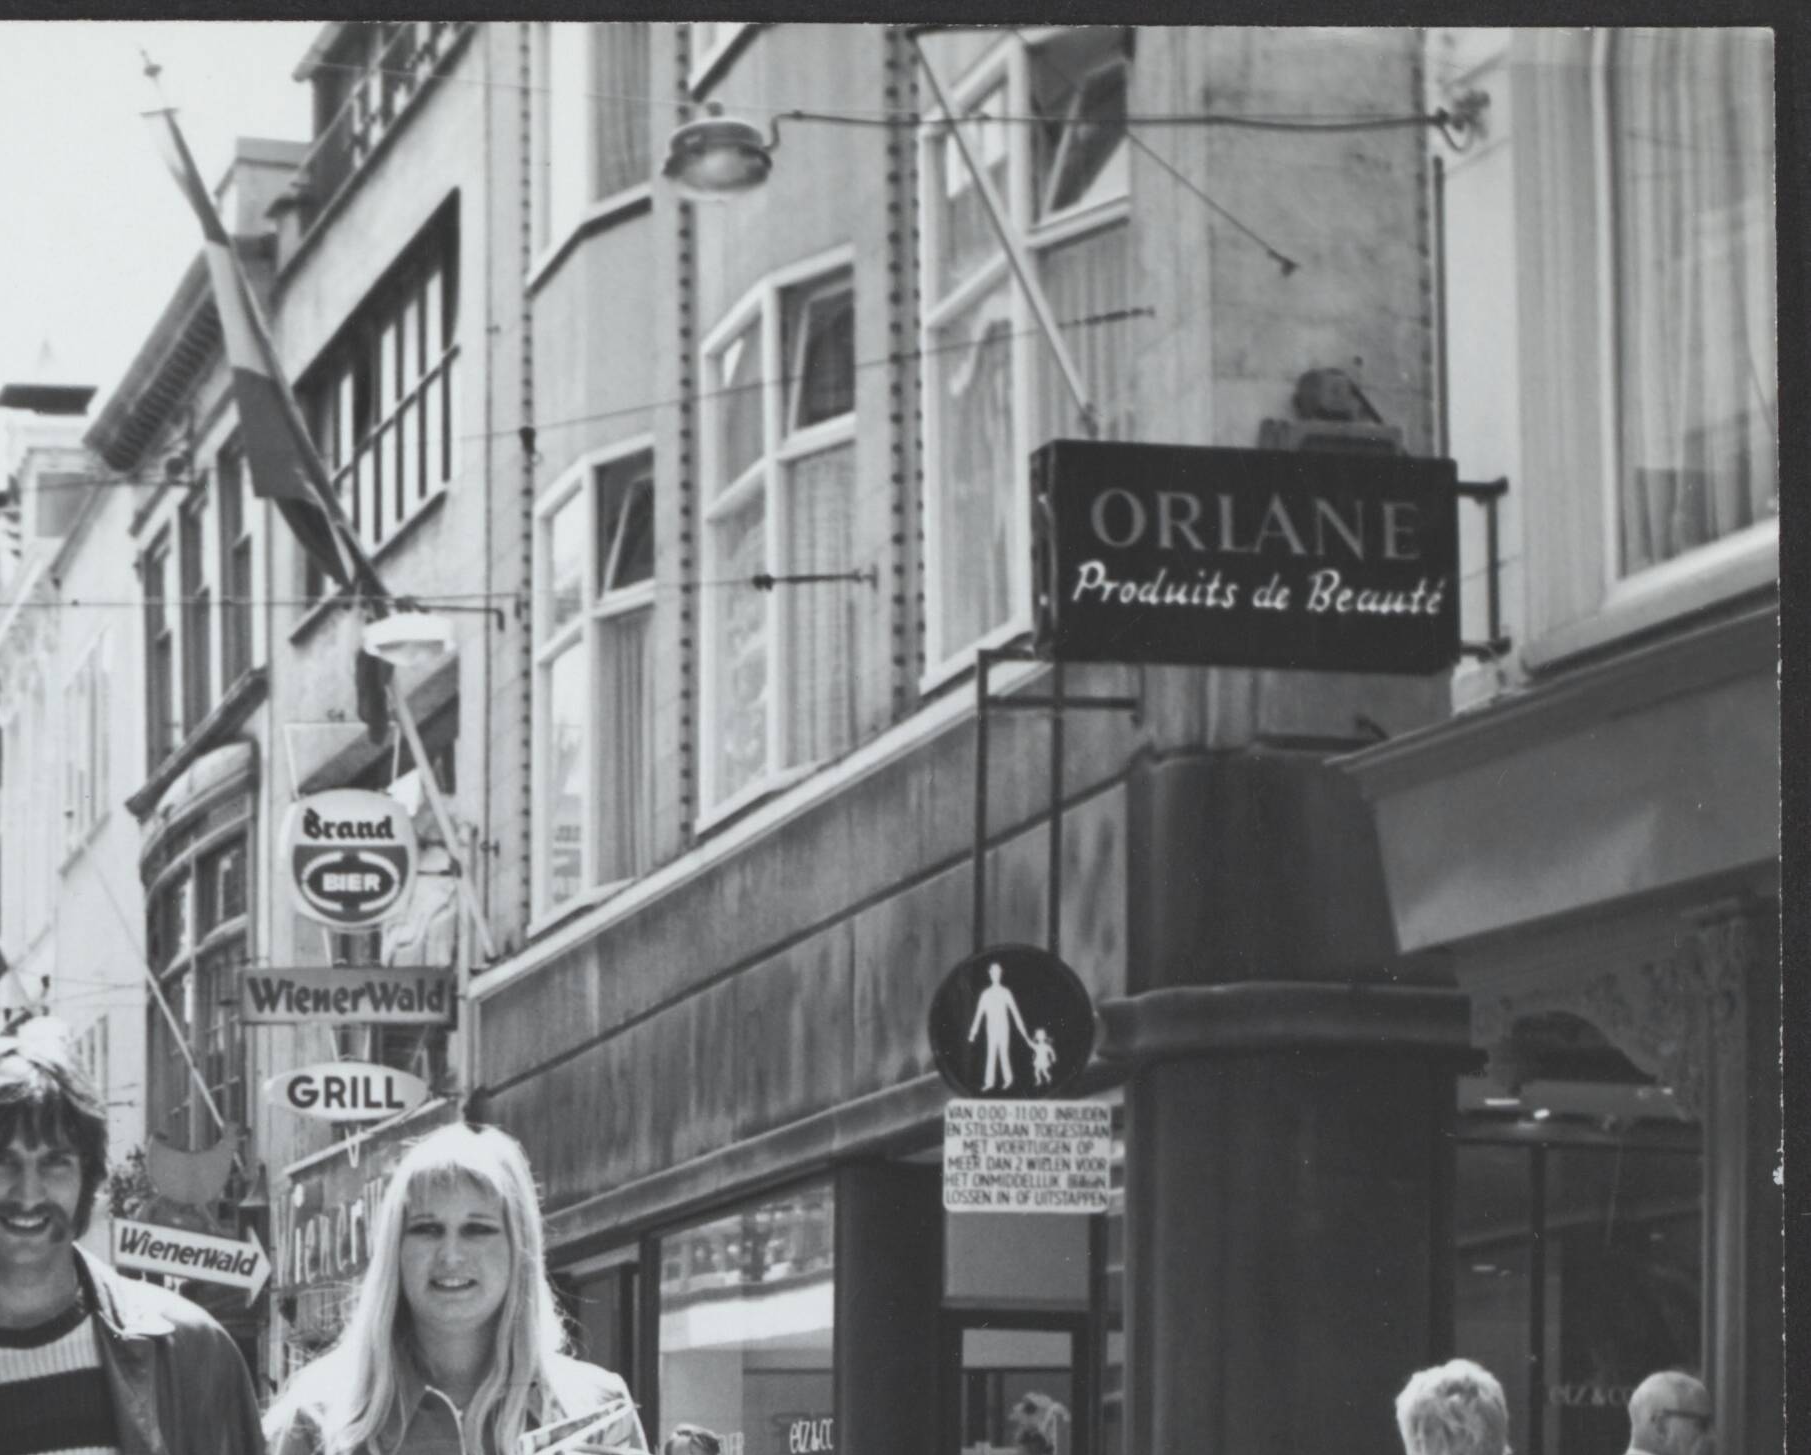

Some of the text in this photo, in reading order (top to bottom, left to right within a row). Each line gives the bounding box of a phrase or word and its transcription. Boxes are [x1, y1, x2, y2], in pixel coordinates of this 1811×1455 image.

[1090, 487, 1422, 562] ORLANE
[1071, 560, 1445, 617] Produits de Beauté
[302, 807, 395, 842] Brand
[321, 872, 383, 895] BIER
[286, 1074, 406, 1110] GRILL
[948, 1105, 973, 1120] VAN
[965, 1122, 1030, 1138] STILSTAAN
[1035, 1123, 1110, 1138] TOEGESTAAN
[962, 1138, 1094, 1154] MET VOERTUIGEN OP
[947, 1155, 981, 1171] MEER
[986, 1156, 1012, 1171] DAN
[1076, 1158, 1107, 1172] VOOR
[945, 1172, 969, 1187] HET
[945, 1189, 992, 1204] LOSSEN
[1016, 1189, 1030, 1205] OF
[1035, 1190, 1108, 1206] UITSTAPPEN
[119, 1226, 259, 1277] Wienerwald
